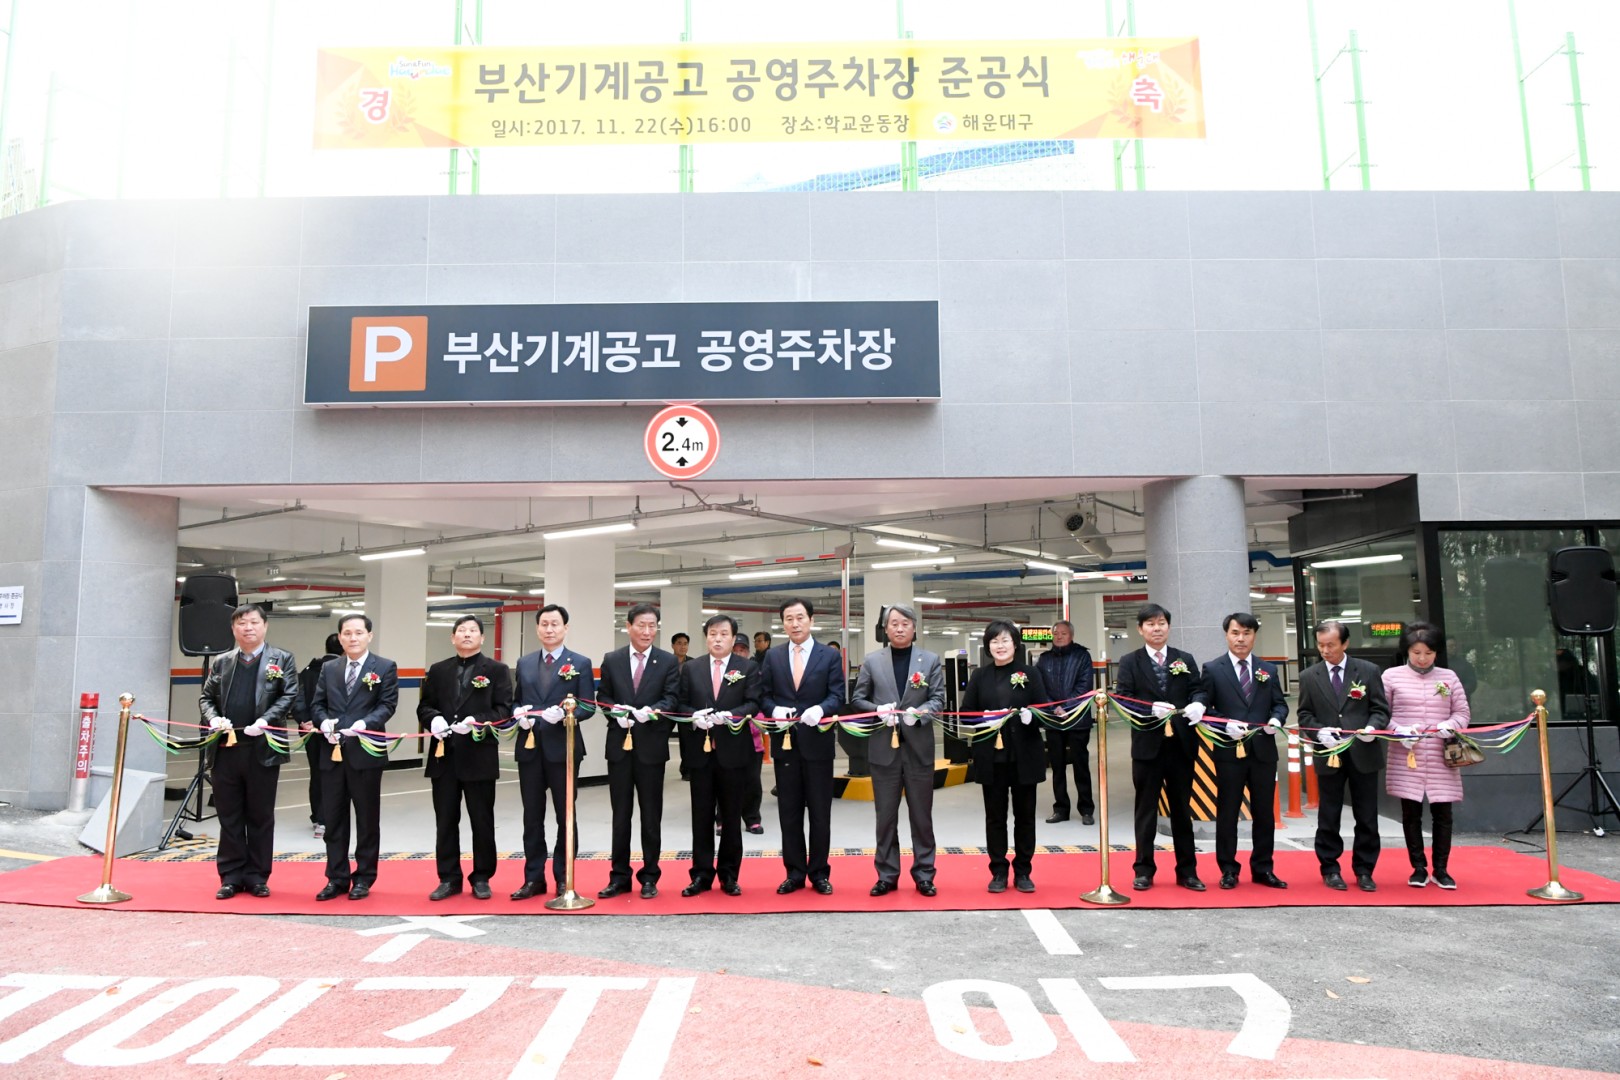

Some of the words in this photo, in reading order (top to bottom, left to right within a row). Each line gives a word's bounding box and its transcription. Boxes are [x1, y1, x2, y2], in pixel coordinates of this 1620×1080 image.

[474, 60, 709, 104] 부산기계공고
[726, 56, 920, 103] 공영주차장
[938, 55, 1050, 99] 준공식
[1133, 78, 1162, 110] 축
[361, 90, 390, 121] 경
[491, 118, 586, 138] 일시:2017.
[595, 119, 625, 135] 11.
[634, 116, 752, 136] 22(수)16:00
[780, 113, 910, 135] 장소:학교운동장
[962, 113, 1034, 131] 해운대구
[363, 326, 413, 382] P
[443, 330, 681, 375] 부산기계공고
[697, 327, 896, 373] 공영주차장
[661, 431, 704, 453] 2.4m
[76, 714, 92, 773] 출차주의
